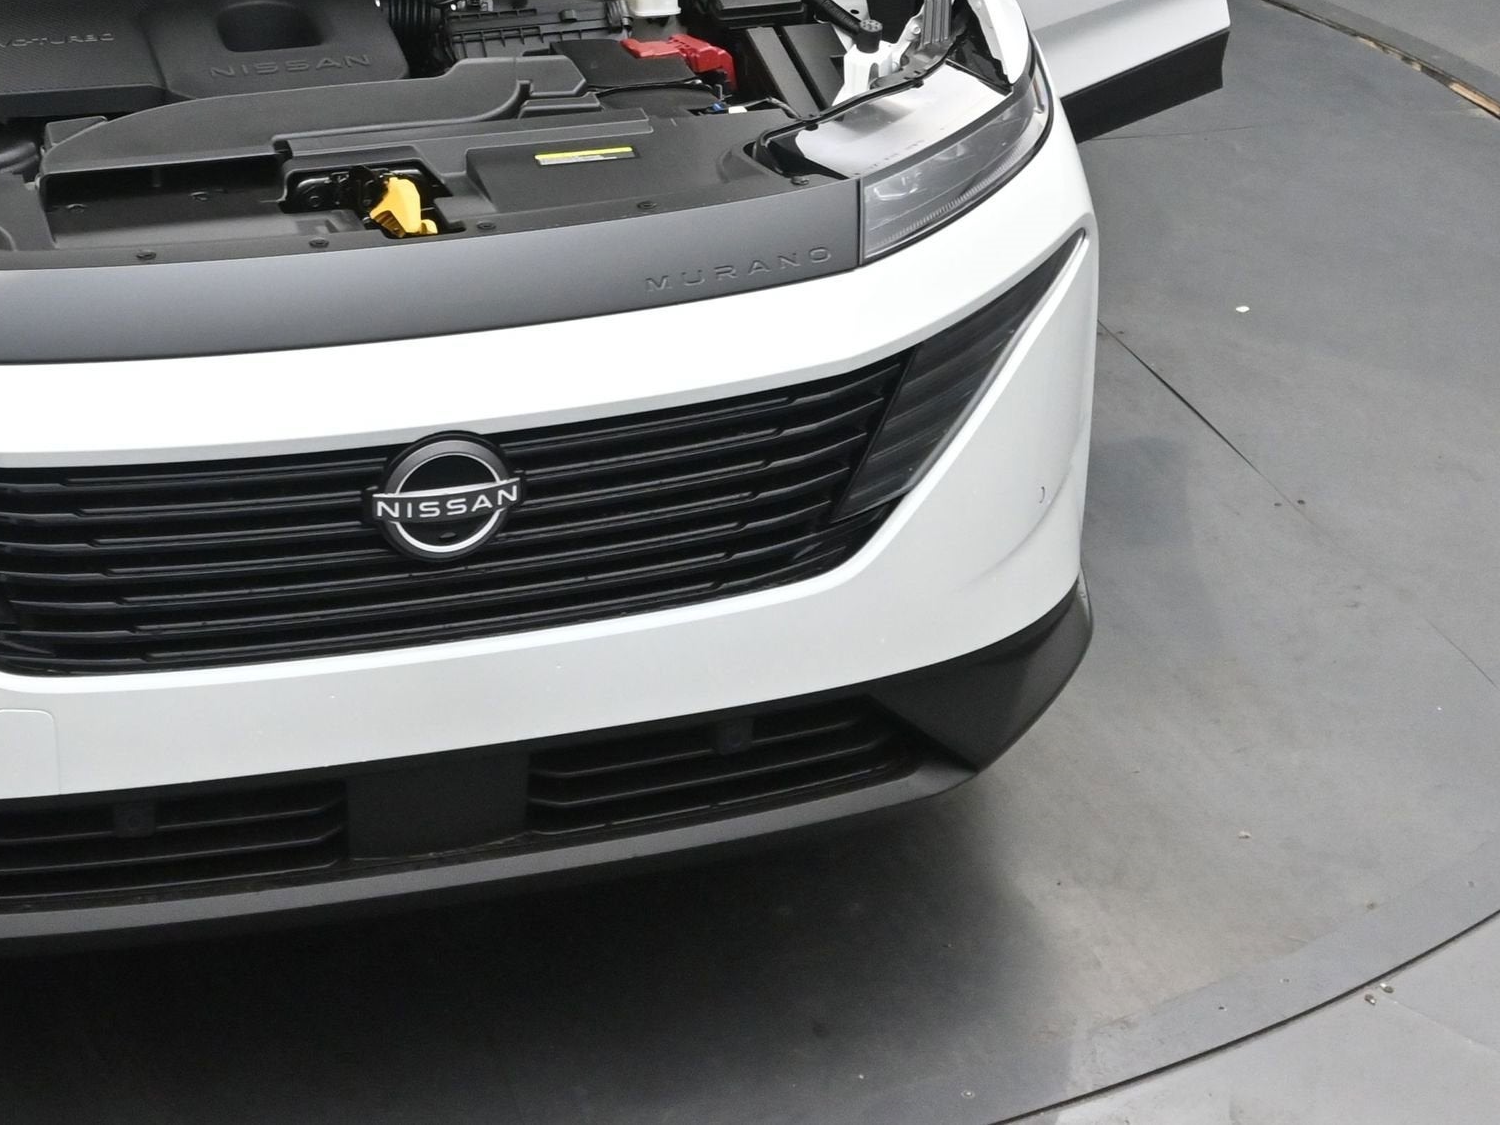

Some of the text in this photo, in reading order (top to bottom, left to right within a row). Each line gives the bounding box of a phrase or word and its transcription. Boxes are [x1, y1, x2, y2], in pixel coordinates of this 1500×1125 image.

[210, 54, 373, 77] NISSAN
[645, 246, 833, 292] MURANO
[376, 485, 517, 518] NISSAN
